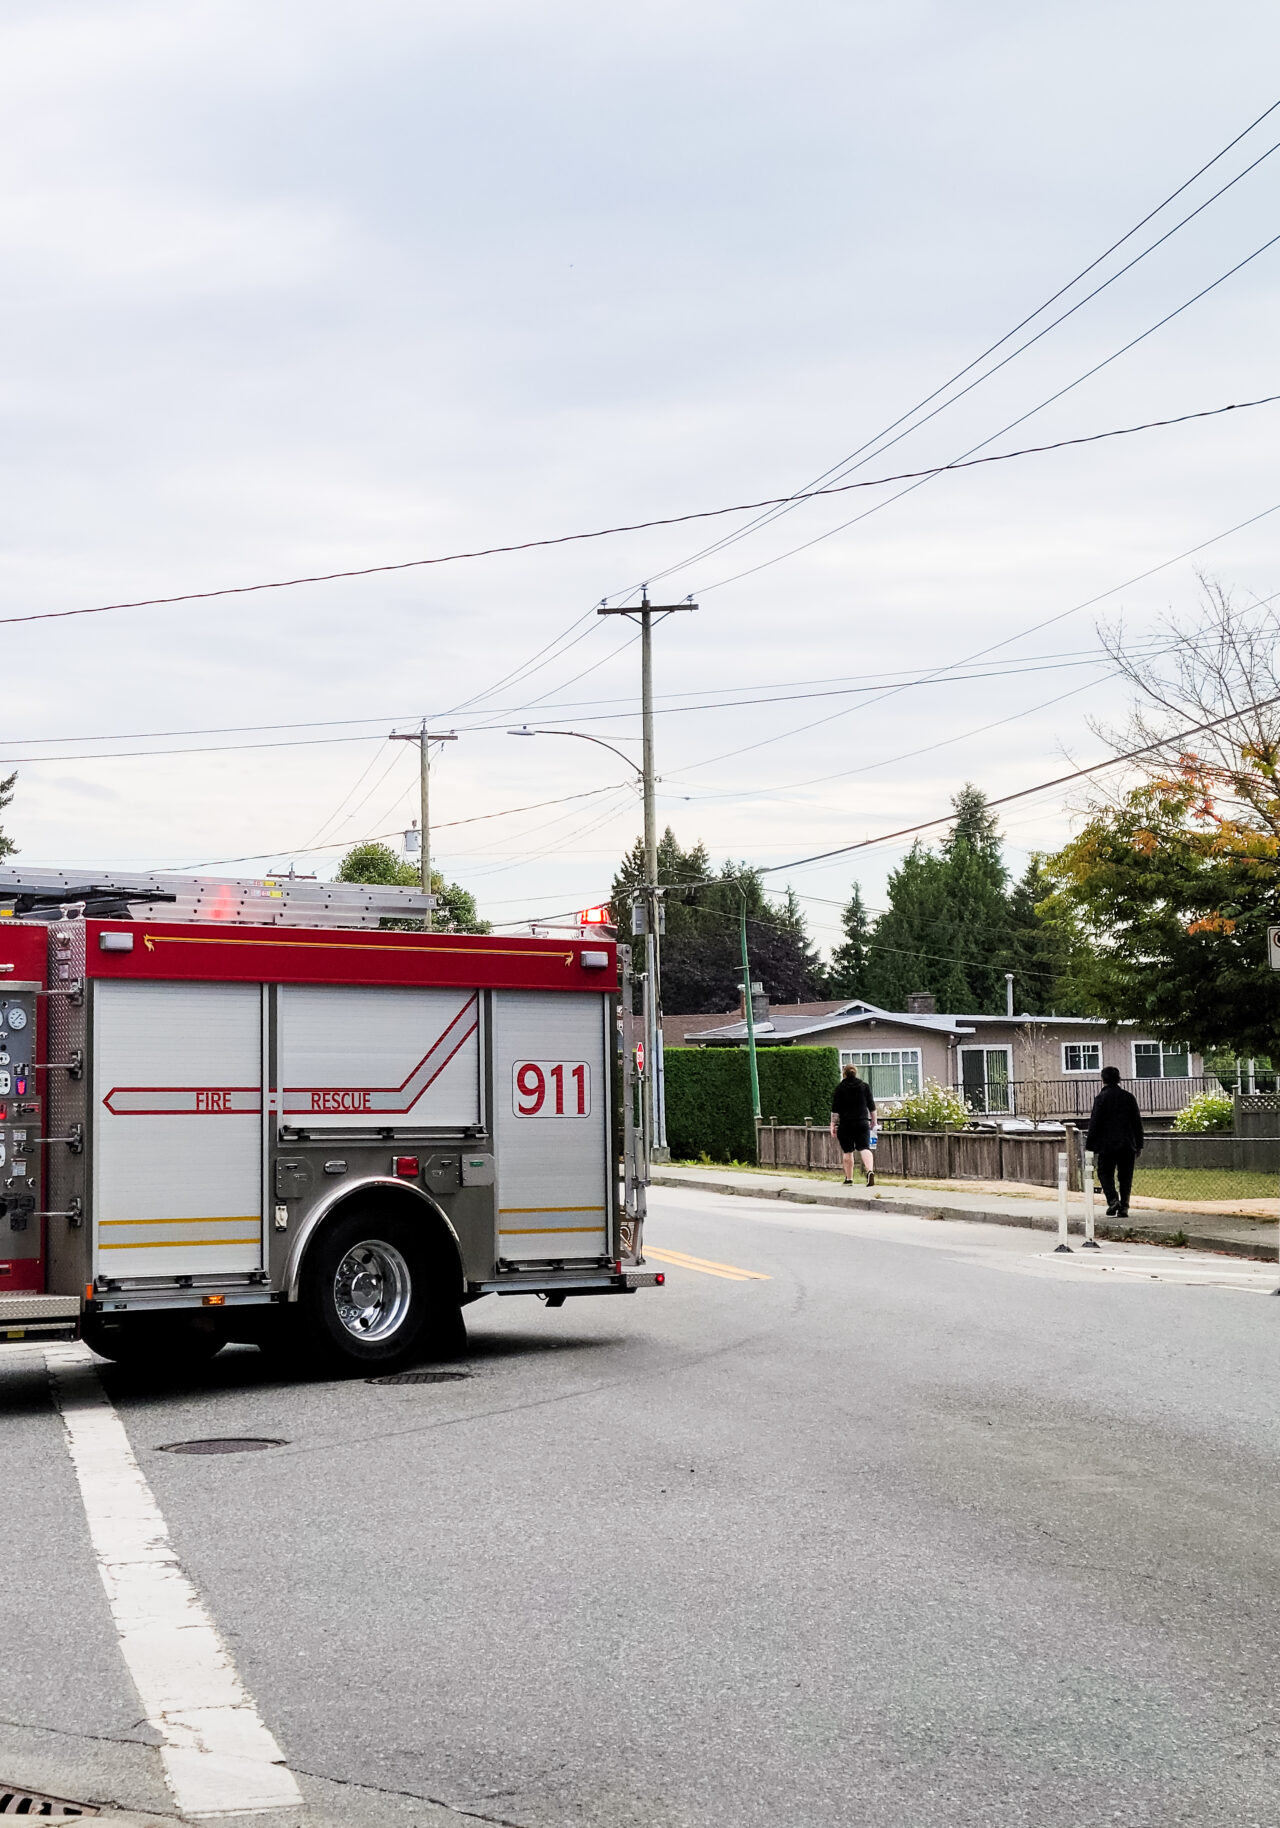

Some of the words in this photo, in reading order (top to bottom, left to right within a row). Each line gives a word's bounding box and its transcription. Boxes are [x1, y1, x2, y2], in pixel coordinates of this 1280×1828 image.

[195, 1092, 232, 1111] FIRE
[311, 1092, 371, 1110] RESCUE
[516, 1063, 586, 1116] 911
